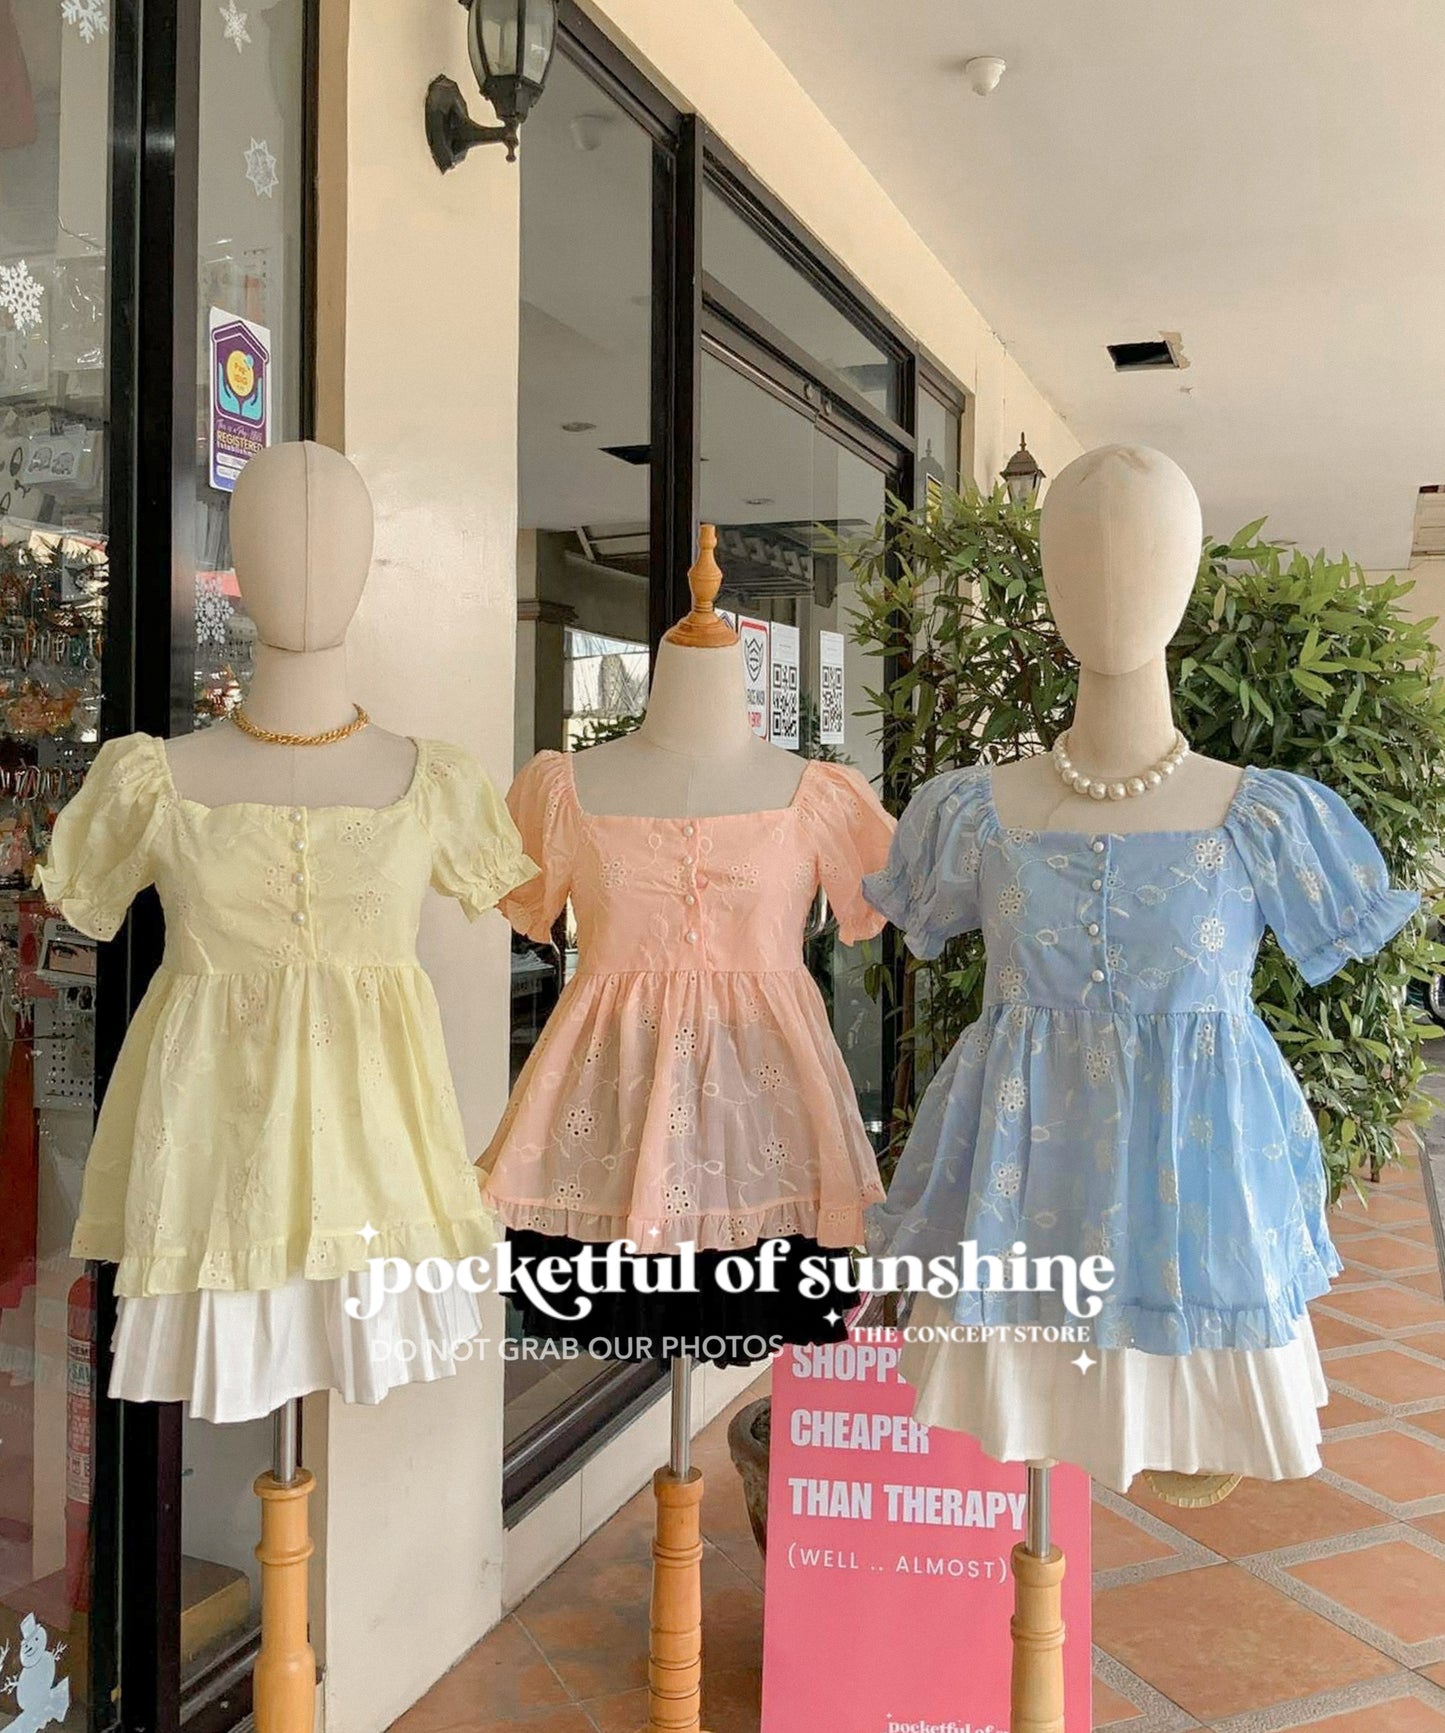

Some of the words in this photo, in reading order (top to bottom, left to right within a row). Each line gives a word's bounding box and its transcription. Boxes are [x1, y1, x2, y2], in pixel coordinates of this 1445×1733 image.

[216, 430, 263, 452] REGISTERED
[792, 1344, 907, 1384] SHOPP
[790, 1409, 930, 1454] CHEAPER
[788, 1478, 873, 1520] THAN
[883, 1484, 1027, 1531] THERAPY
[895, 1555, 1008, 1584] ALMOST)
